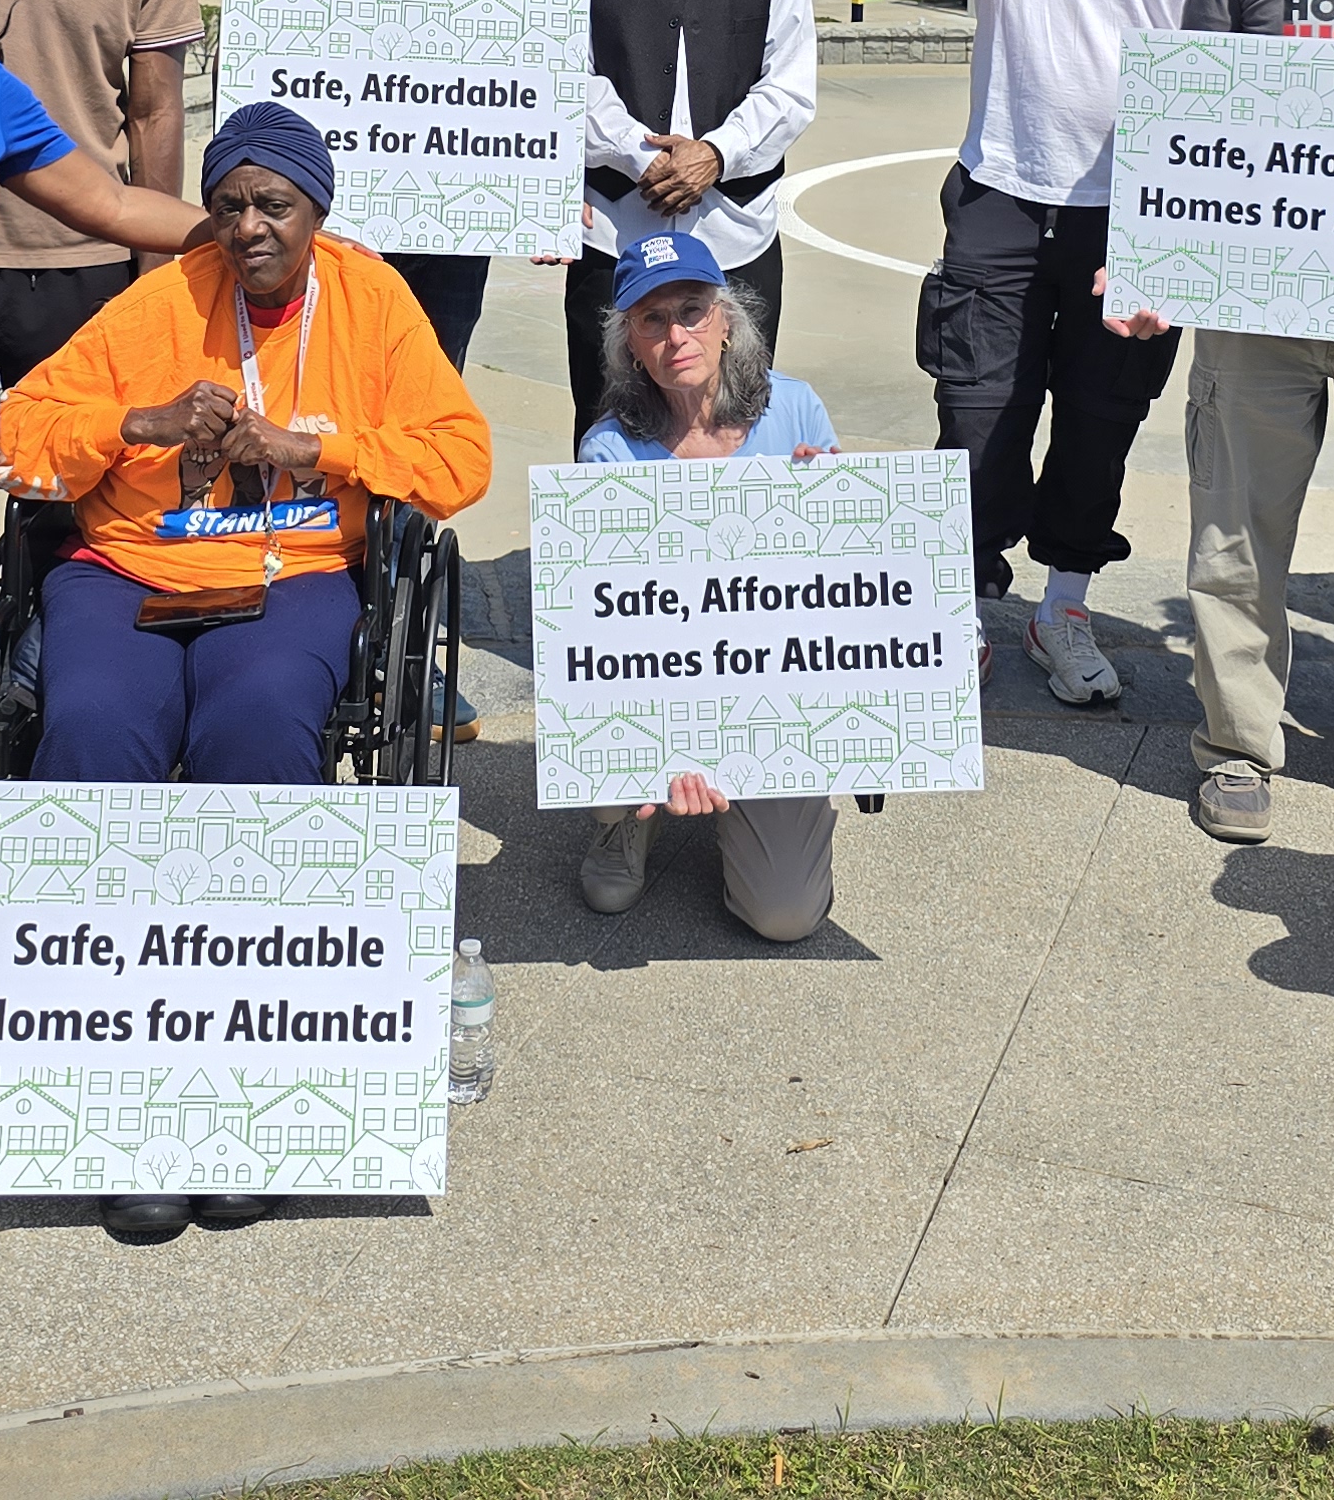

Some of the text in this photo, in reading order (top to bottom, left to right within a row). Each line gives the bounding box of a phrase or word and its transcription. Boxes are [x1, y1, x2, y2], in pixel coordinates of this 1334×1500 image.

[271, 68, 537, 109] Safe, Affordable
[368, 124, 416, 154] for
[423, 126, 558, 160] Atlanta!
[1169, 134, 1255, 178] Safe,
[1139, 186, 1261, 226] Homes
[1273, 198, 1326, 231] for
[645, 238, 669, 248] KNOW
[593, 572, 913, 622] Safe, Affordable
[567, 632, 944, 682] Homes for Atlanta!
[13, 922, 384, 975] Safe, Affordable
[147, 998, 215, 1042] for
[225, 998, 414, 1044] Atlanta!
